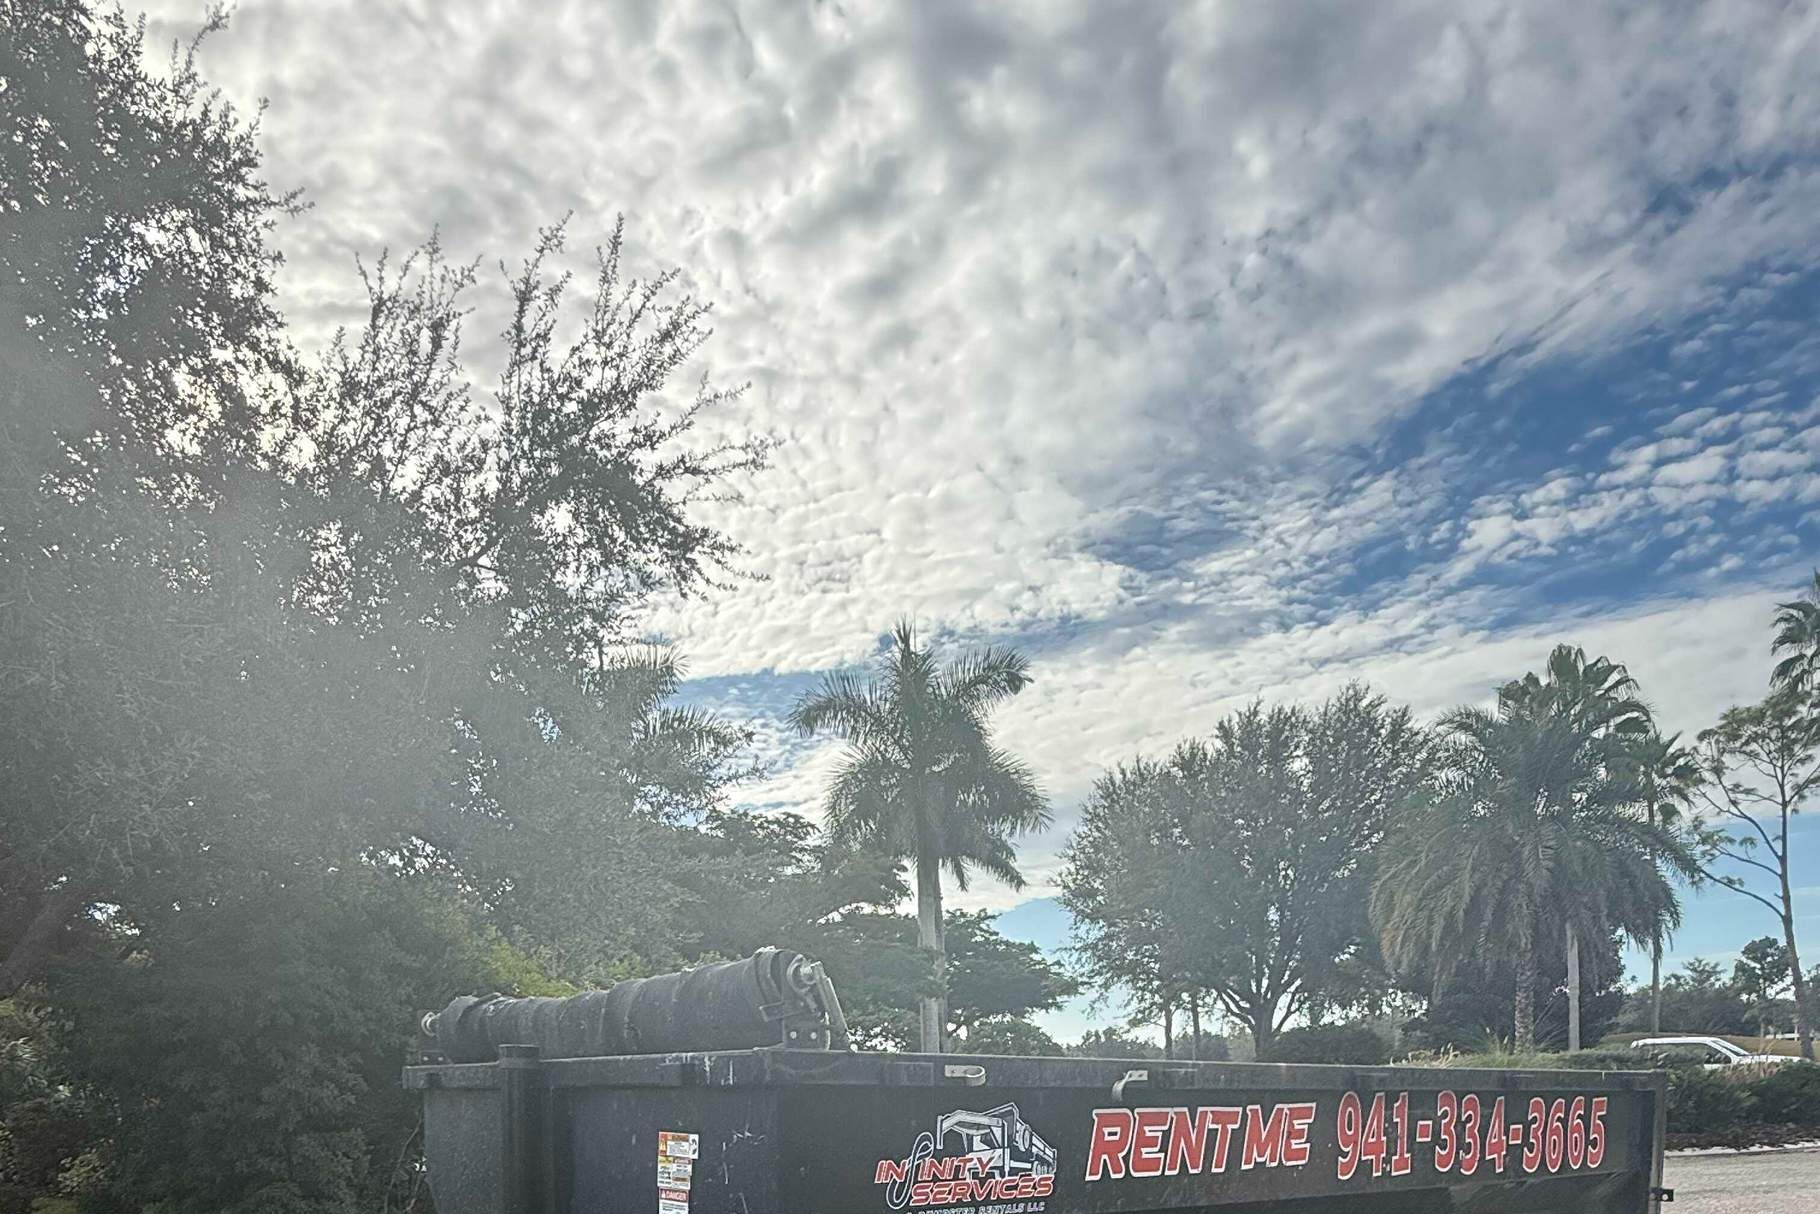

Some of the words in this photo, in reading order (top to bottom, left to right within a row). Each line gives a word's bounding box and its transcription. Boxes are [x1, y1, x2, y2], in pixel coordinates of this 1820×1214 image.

[1337, 1090, 1608, 1180] 941-334-3665
[875, 1131, 995, 1184] INFINITY
[909, 1175, 1055, 1206] SERVICES
[1027, 1202, 1046, 1213] LLC
